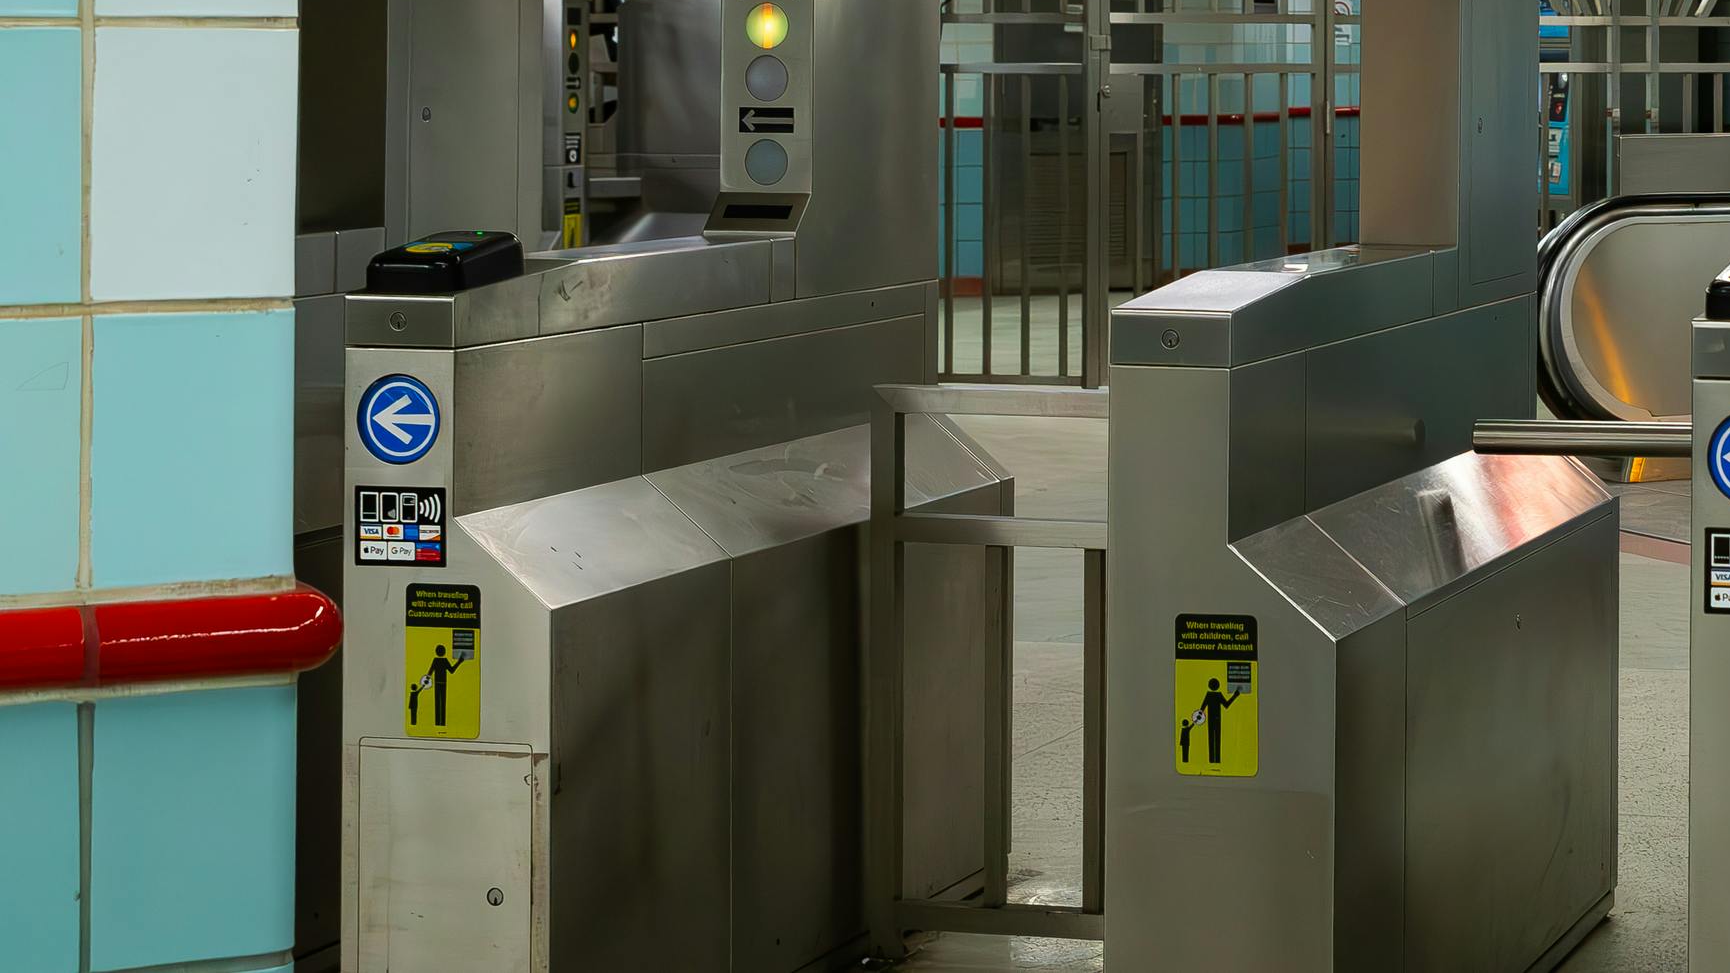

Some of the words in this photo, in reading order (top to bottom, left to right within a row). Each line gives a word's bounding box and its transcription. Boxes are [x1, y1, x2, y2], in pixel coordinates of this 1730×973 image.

[370, 546, 384, 555] Pay
[399, 547, 412, 556] Pay
[1186, 621, 1209, 629] When
[1210, 621, 1244, 631] traveling
[1181, 632, 1198, 640] with
[1177, 642, 1216, 650] Customer
[1217, 643, 1253, 651] Assistant
